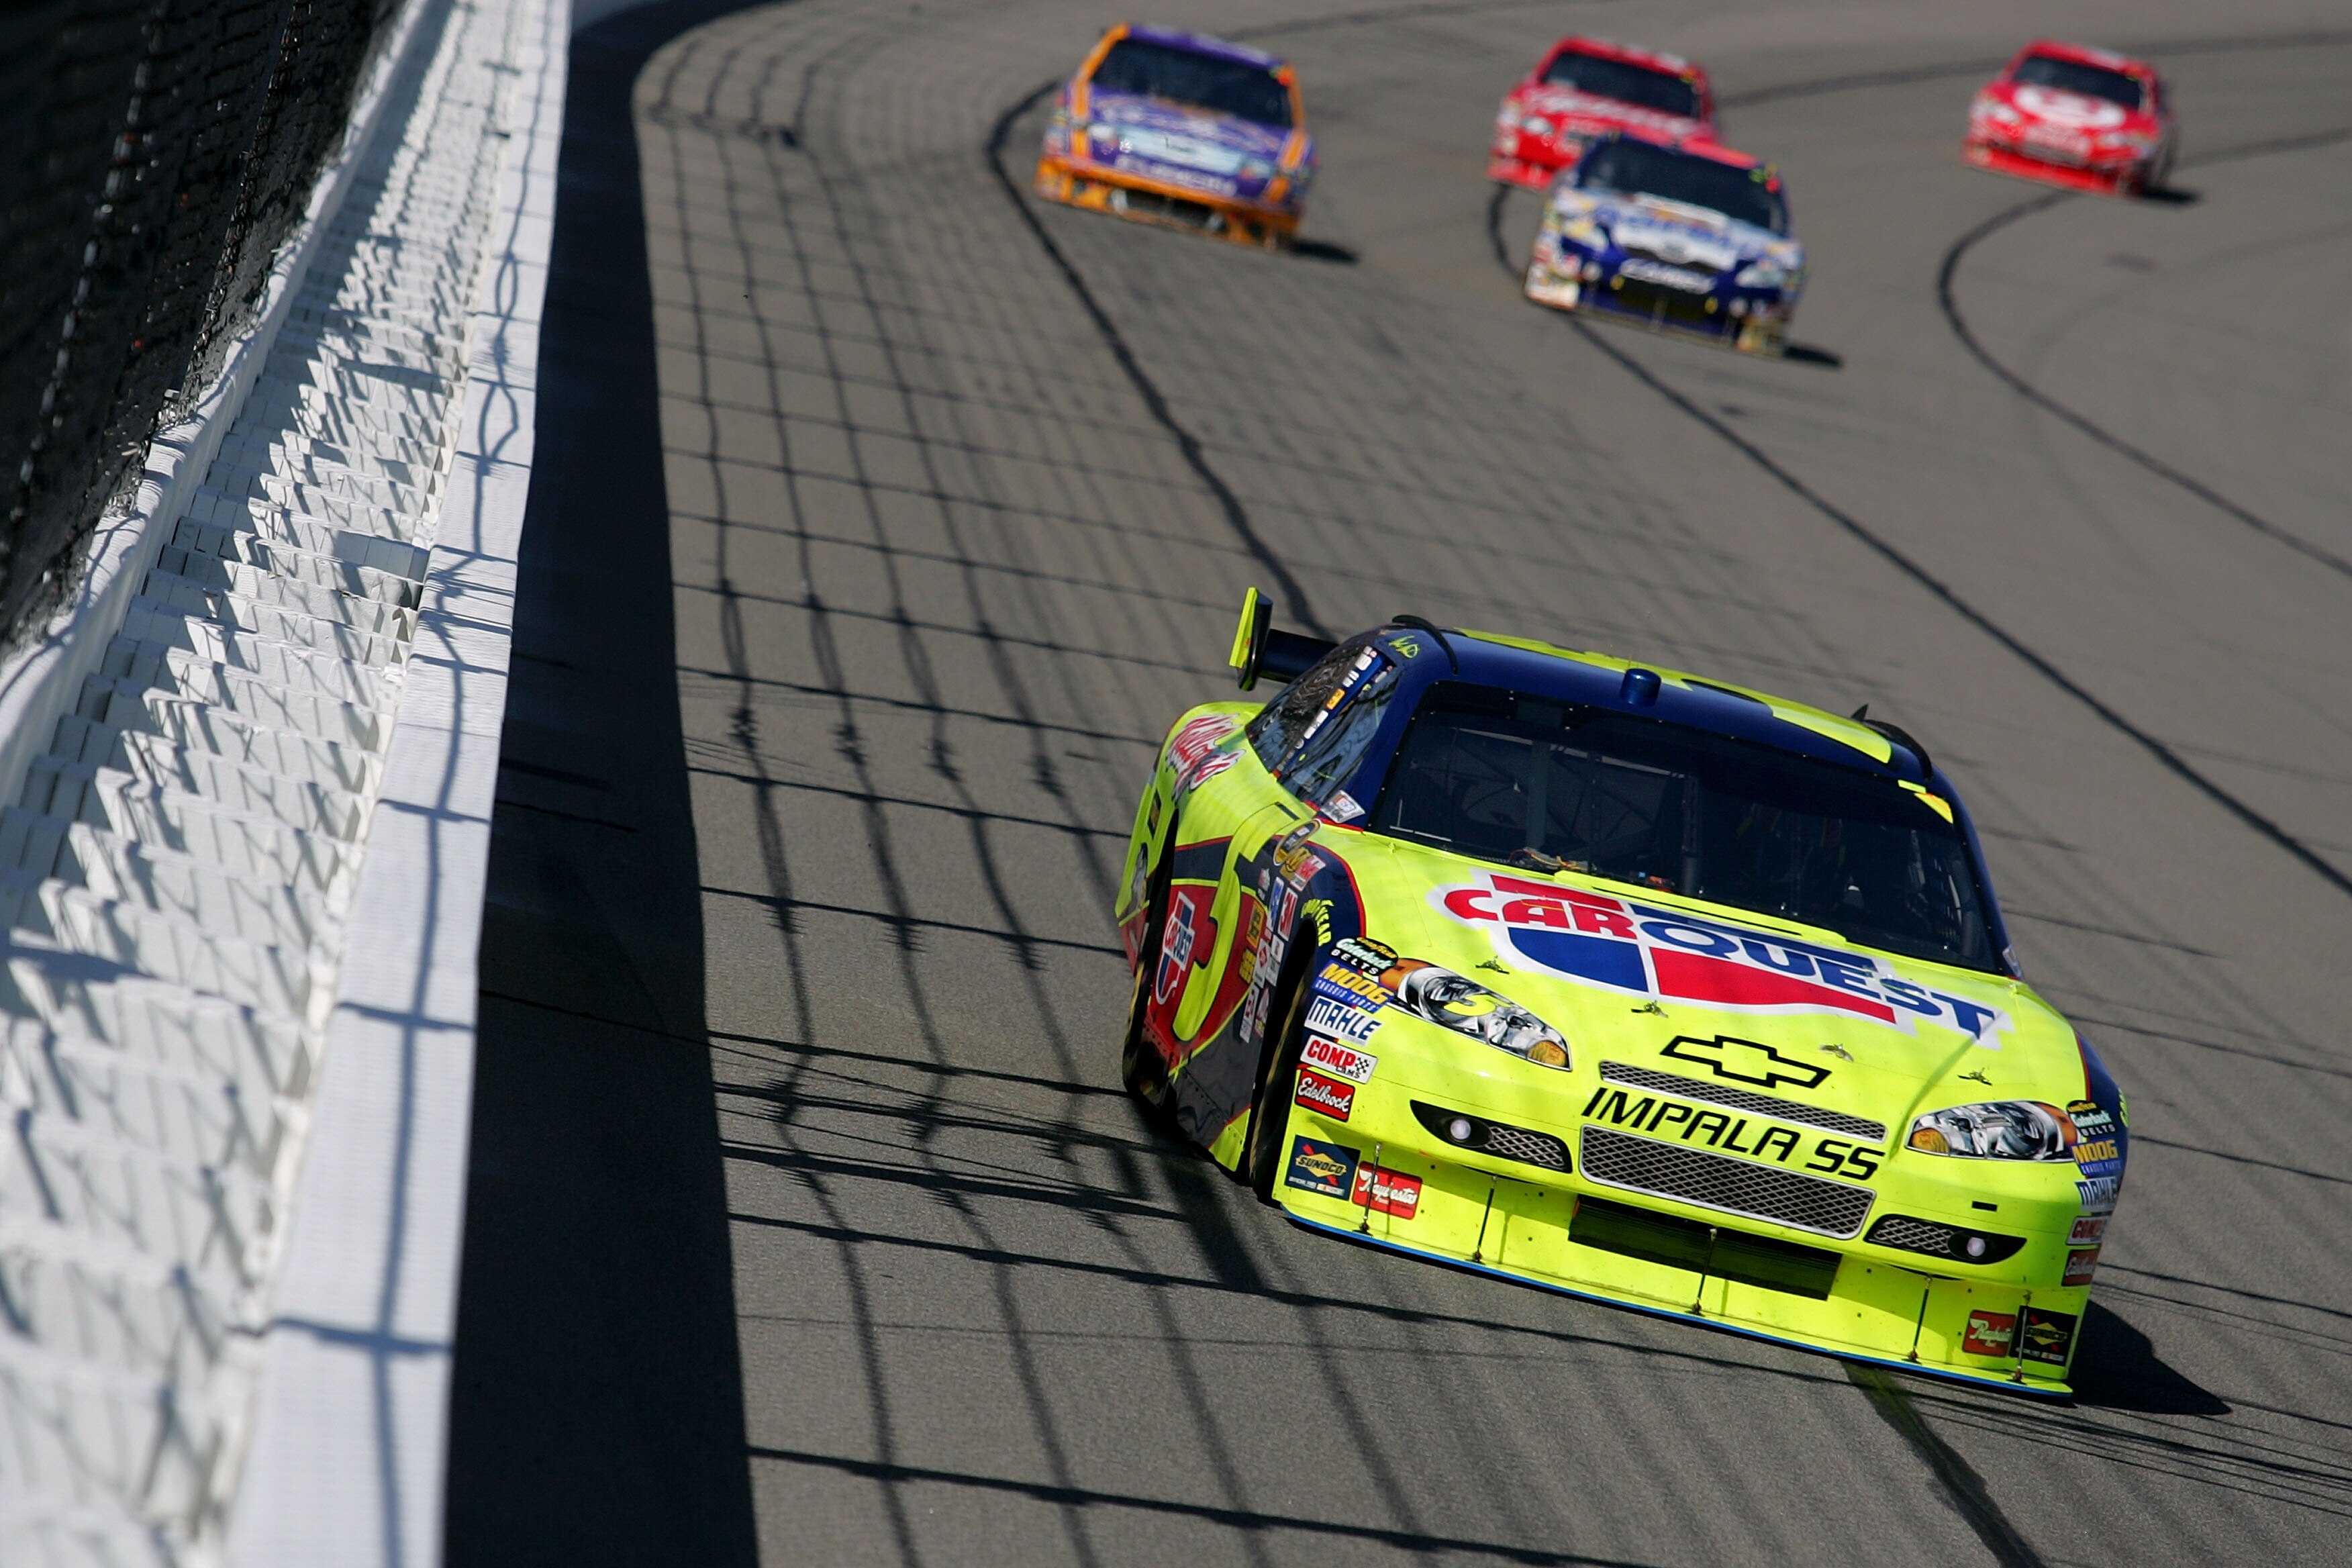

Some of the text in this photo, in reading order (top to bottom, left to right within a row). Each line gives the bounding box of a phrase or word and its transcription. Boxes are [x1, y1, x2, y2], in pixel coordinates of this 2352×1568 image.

[1331, 948, 1379, 975] BELTS
[1444, 889, 1996, 1039] CARQUEST
[1318, 963, 1395, 1005] MOOG
[1308, 997, 1382, 1040] MAHLE
[1307, 1040, 1357, 1069] COMP
[1297, 1077, 1353, 1112] Edelbrock
[1581, 1087, 1885, 1181] IMPALA SS
[1297, 1156, 1344, 1174] SUNOCO
[2071, 1140, 2119, 1164] MOOG
